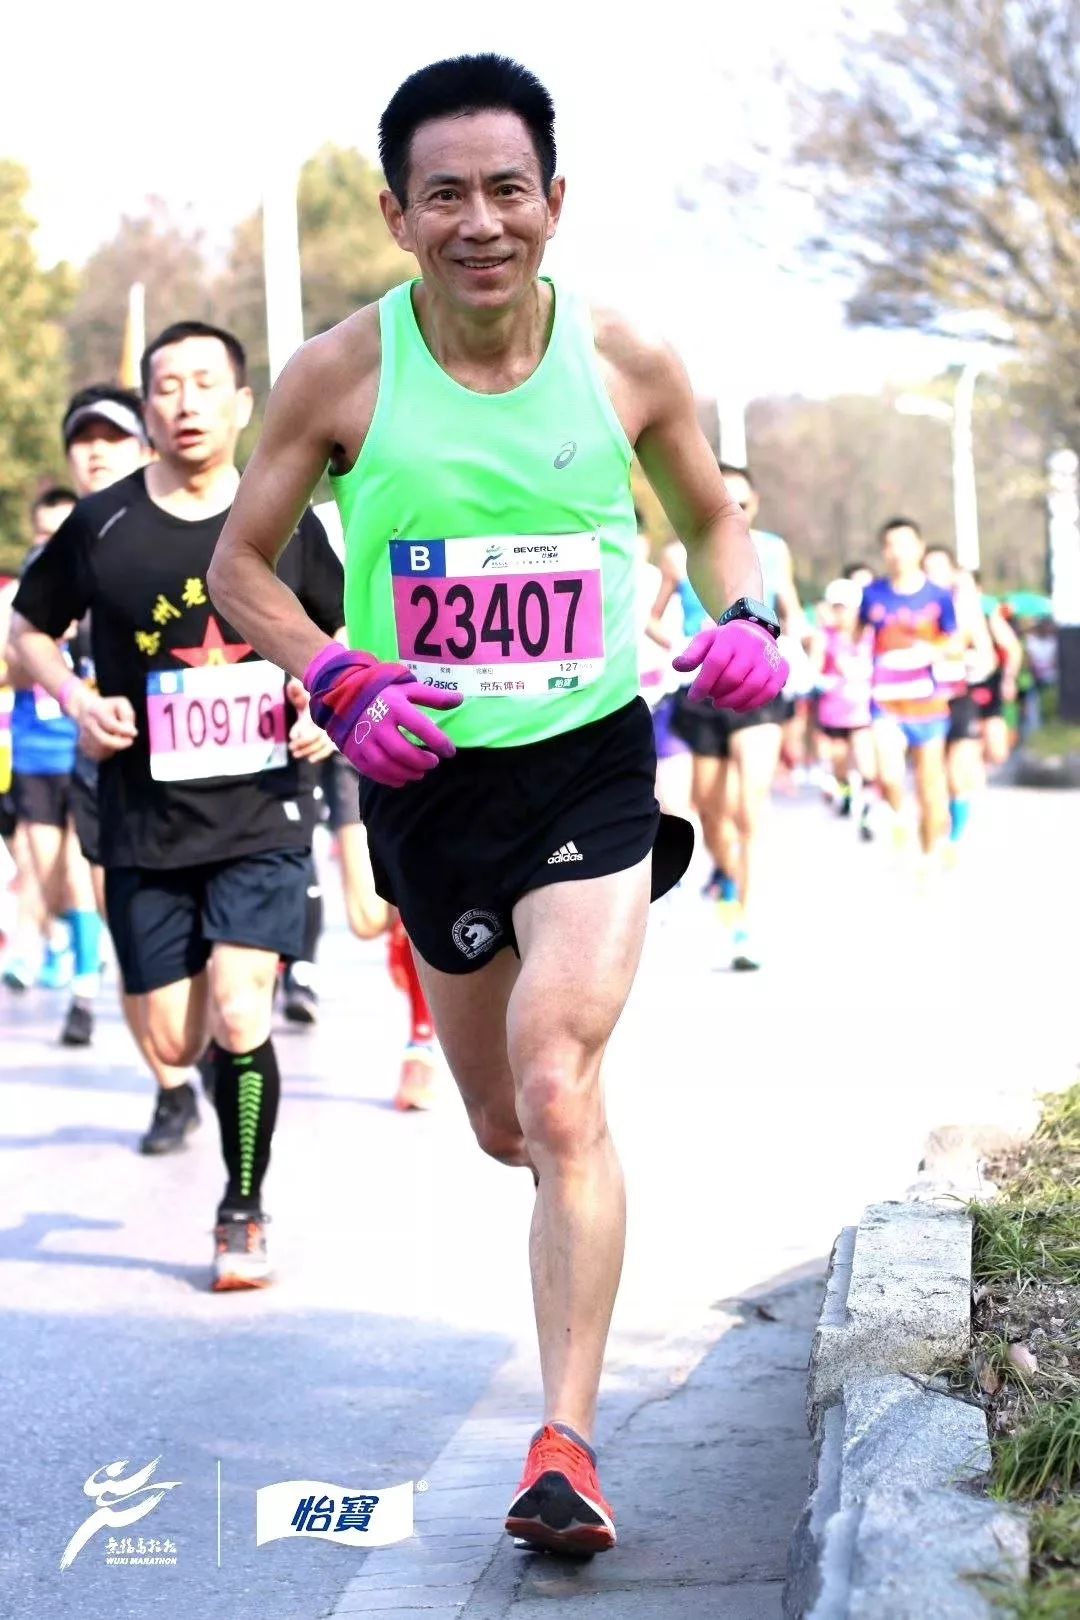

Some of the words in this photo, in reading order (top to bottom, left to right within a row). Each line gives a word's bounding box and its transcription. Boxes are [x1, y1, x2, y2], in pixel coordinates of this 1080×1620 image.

[409, 545, 431, 571] B
[513, 545, 558, 554] BEVERLY
[410, 578, 583, 660] 23407
[480, 680, 525, 692] 京东体育
[162, 693, 275, 751] 10976
[547, 852, 583, 865] adidas
